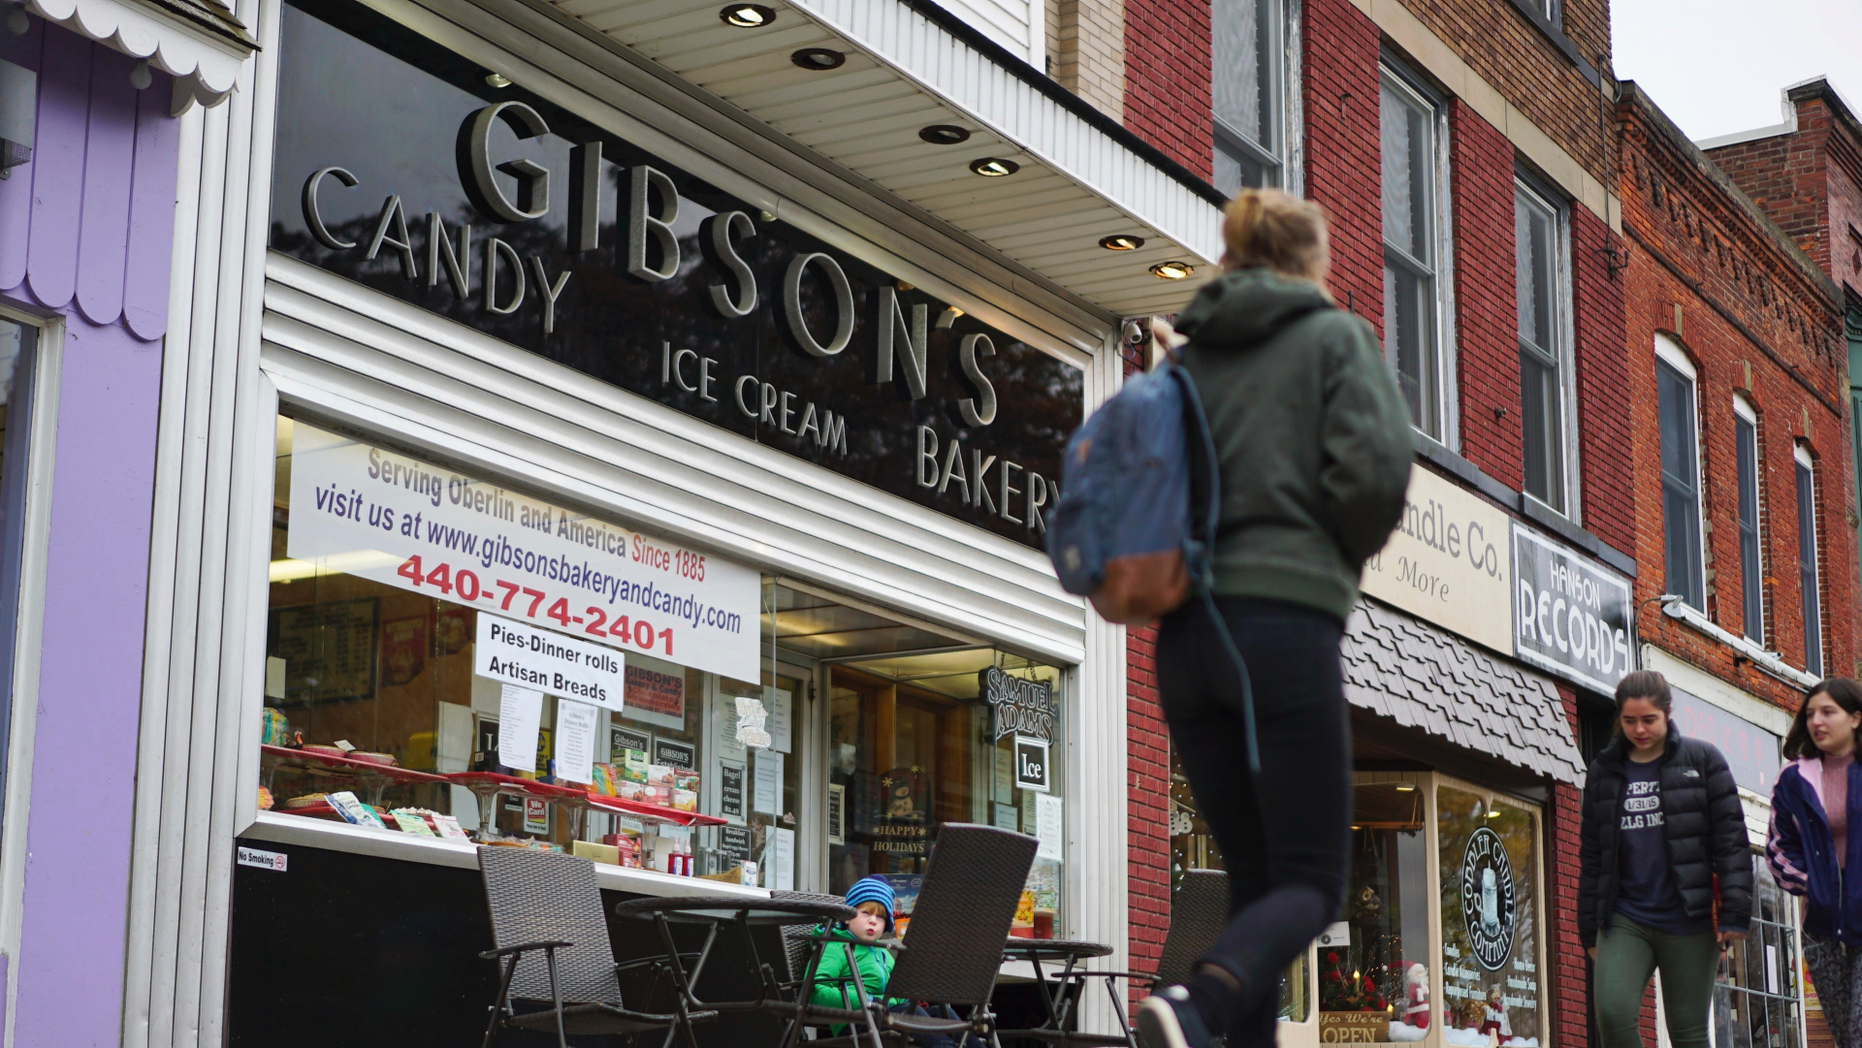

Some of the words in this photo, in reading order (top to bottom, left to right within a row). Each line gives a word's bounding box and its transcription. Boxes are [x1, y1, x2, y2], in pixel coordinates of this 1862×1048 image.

[302, 166, 572, 334] CANDY
[458, 100, 997, 428] GIBSON'S
[662, 341, 719, 402] ICE
[735, 374, 847, 456] CREAM
[367, 448, 442, 508] Serving
[449, 474, 515, 523] Oberlin
[520, 503, 552, 535] and
[557, 511, 627, 558] America
[632, 534, 671, 572] Since
[675, 548, 706, 583] 1885
[315, 483, 364, 523] visit
[368, 502, 395, 531] us
[400, 511, 423, 540] at
[427, 519, 742, 635] www.gibsonsbakeryandcandy.com
[1393, 499, 1461, 559] ndle
[1467, 520, 1503, 582] Co.
[1396, 555, 1450, 603] More
[1550, 558, 1601, 612] HANSON
[397, 554, 674, 657] 440-774-2401
[1520, 577, 1629, 679] RECORDS
[490, 623, 581, 664] Pies-Dinner
[585, 650, 619, 675] rolls
[488, 656, 548, 687] Artisan
[553, 672, 607, 702] Breads
[625, 665, 682, 688] GIBSON'S
[659, 684, 682, 698] Candy
[987, 667, 1057, 714] SAMUEL
[614, 733, 644, 749] Gibson's
[995, 704, 1054, 748] ADAMS
[660, 747, 689, 761] GIBSON'S
[724, 768, 741, 780] Bagel
[1021, 753, 1042, 779] Ice
[873, 841, 925, 853] HOLIDAYS
[880, 825, 919, 836] HAPPY
[239, 850, 247, 861] No
[248, 852, 274, 867] Smoking
[1319, 1013, 1341, 1025] Yes
[1346, 1013, 1384, 1023] We're
[1323, 1027, 1377, 1043] OPEN
